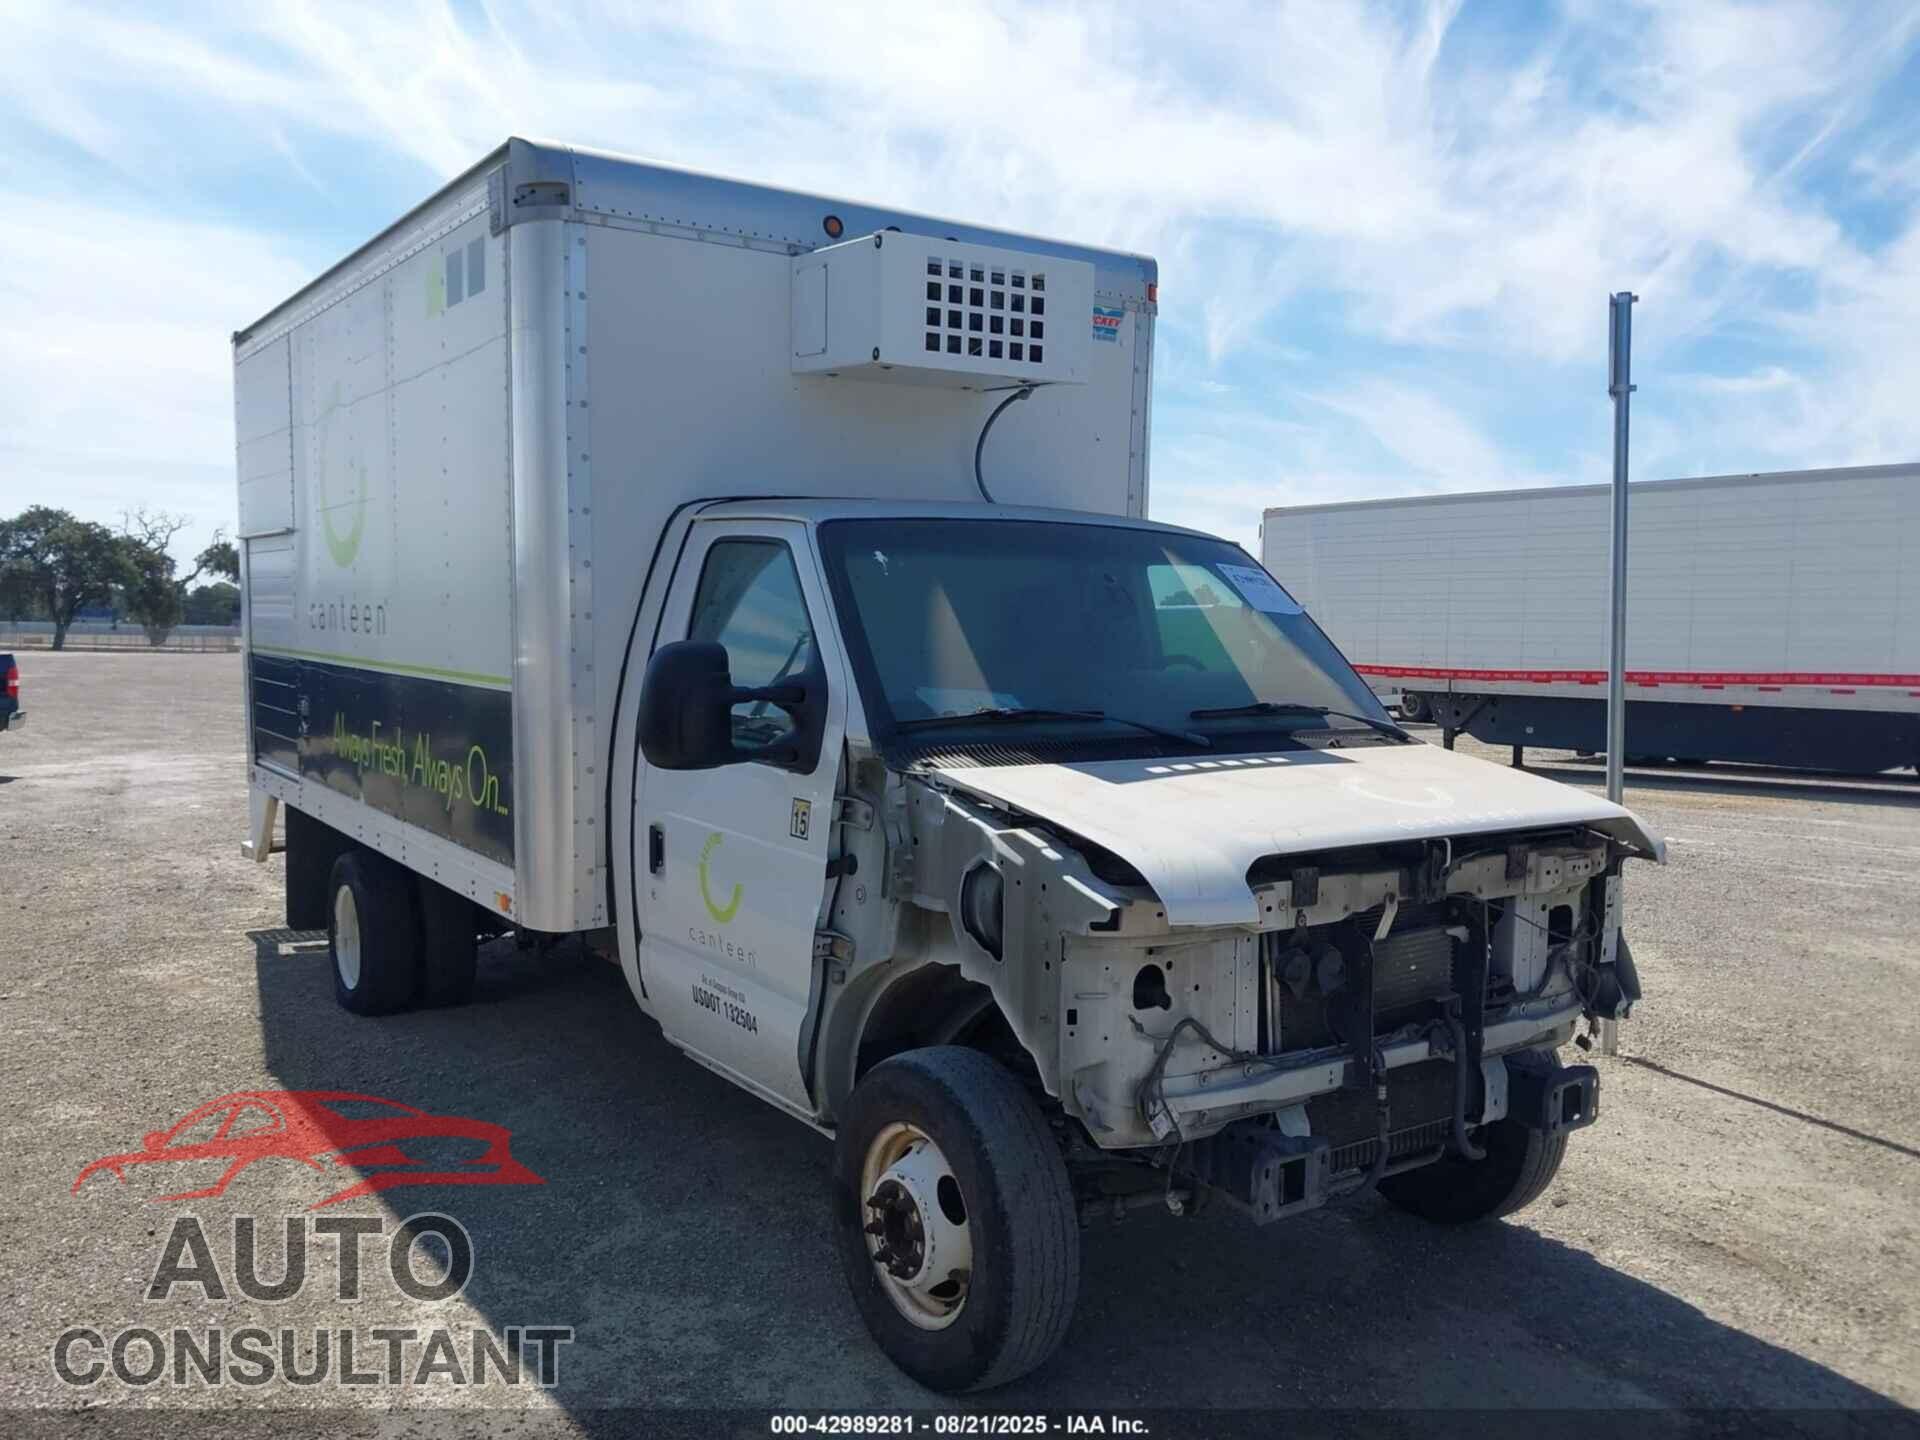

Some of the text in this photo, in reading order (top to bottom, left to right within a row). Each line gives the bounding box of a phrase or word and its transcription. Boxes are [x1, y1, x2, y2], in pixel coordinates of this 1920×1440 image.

[310, 597, 387, 635] canteen
[334, 711, 369, 776] Always
[411, 730, 464, 811] Always
[688, 927, 757, 969] canteen
[692, 983, 721, 1015] USDOT
[723, 1001, 758, 1036] 132504
